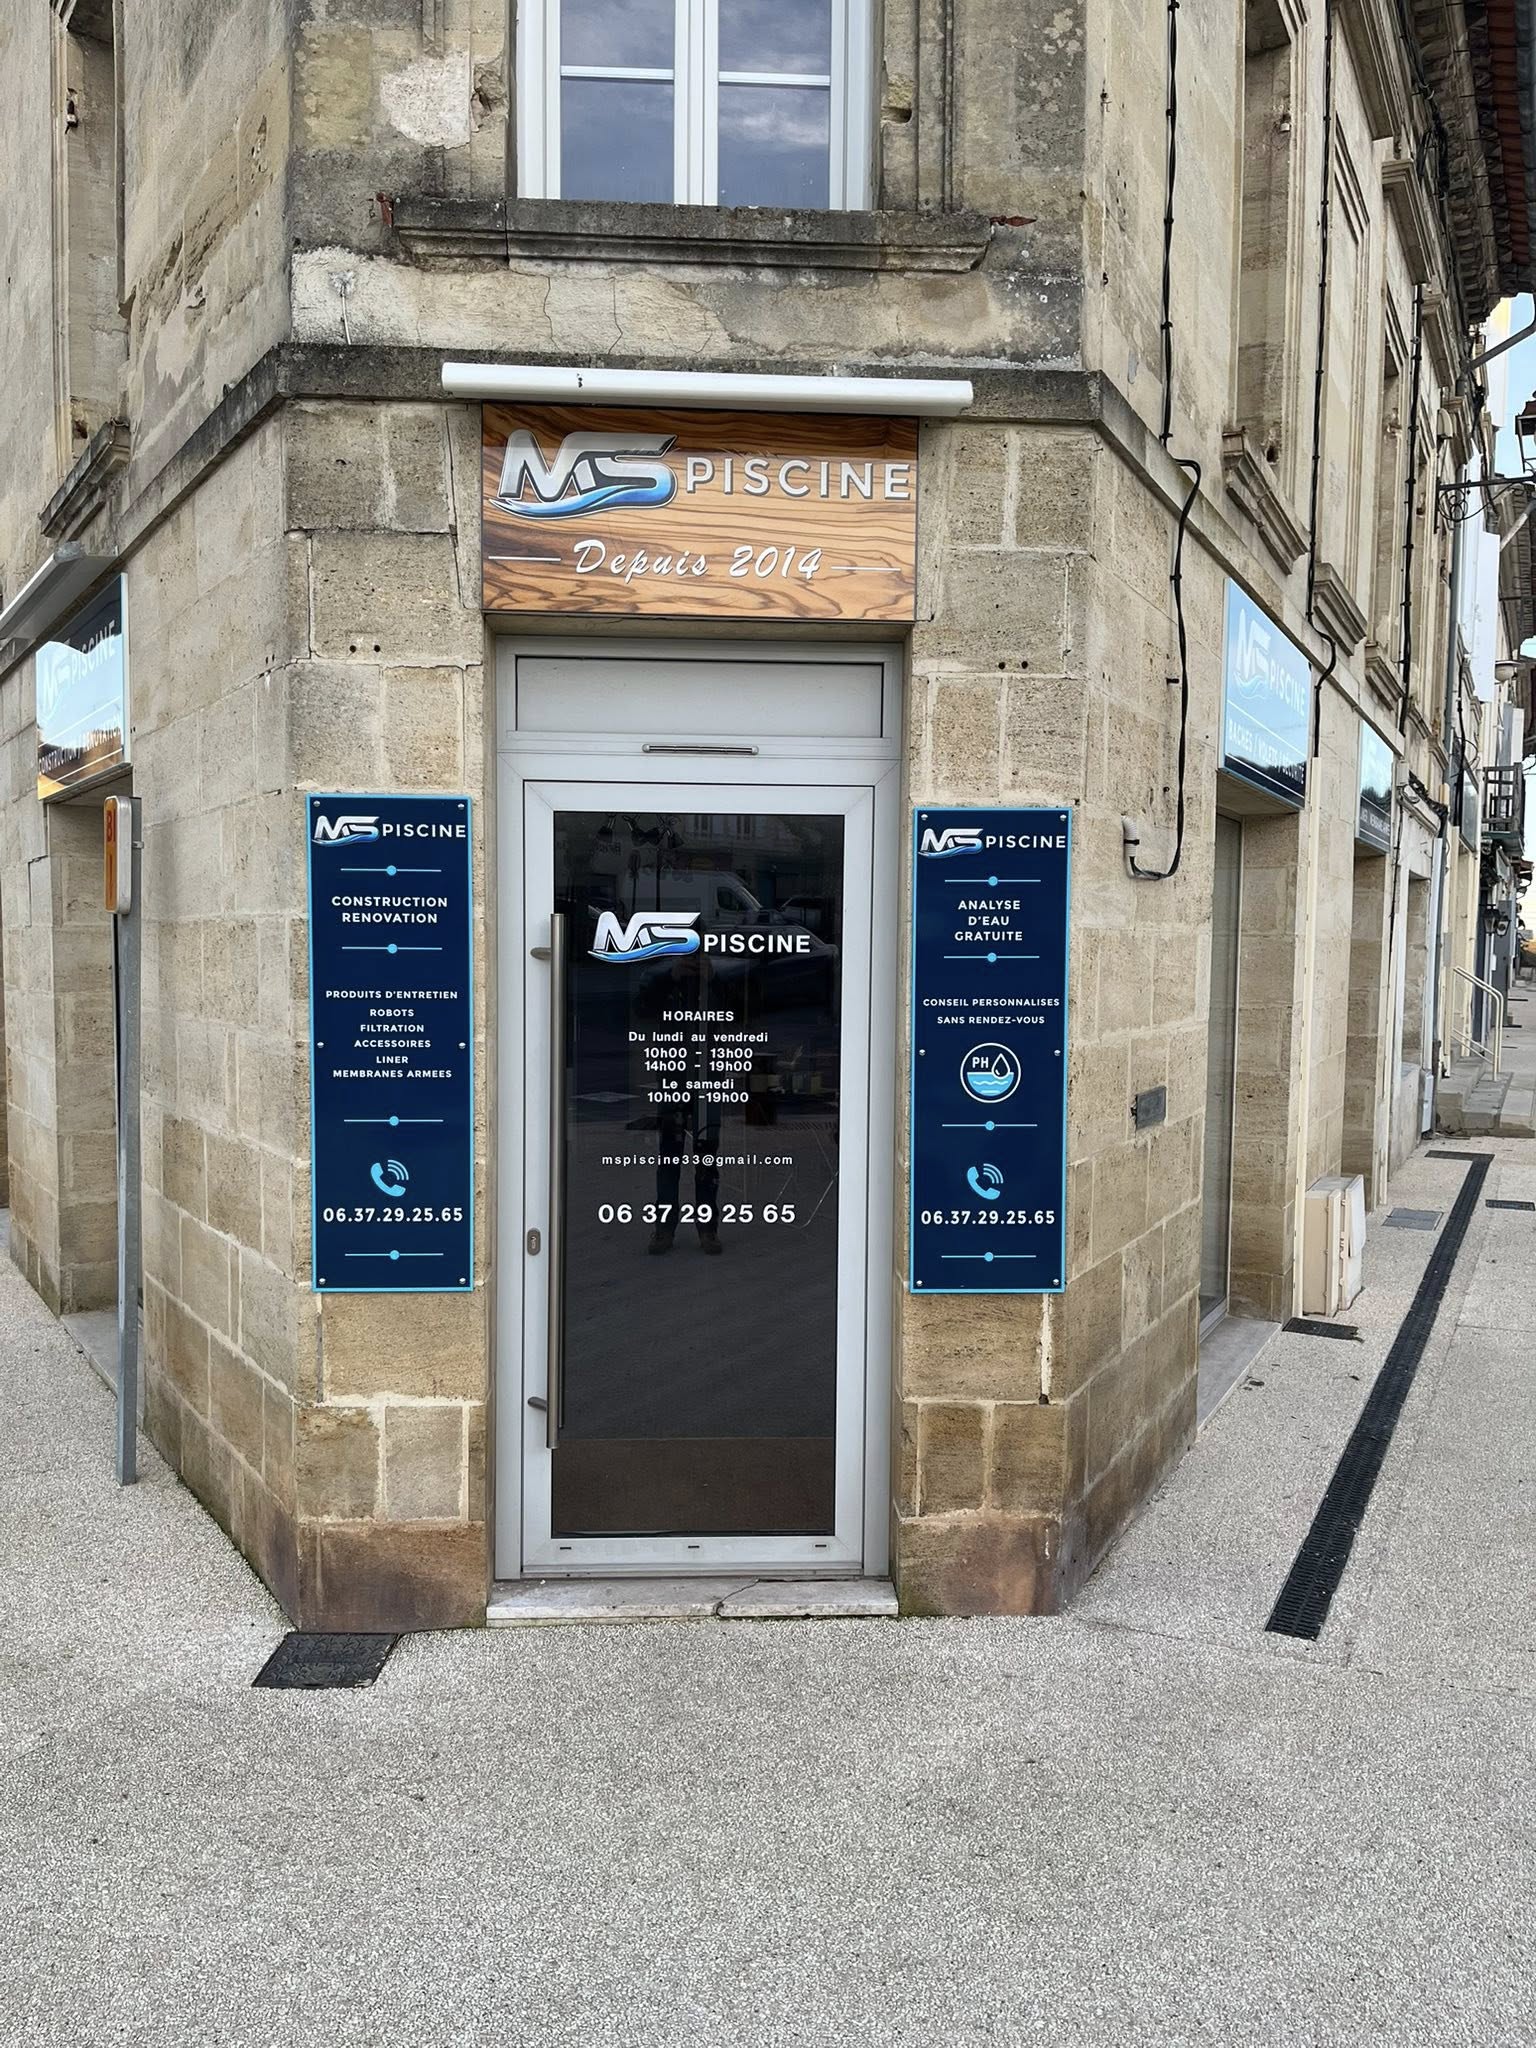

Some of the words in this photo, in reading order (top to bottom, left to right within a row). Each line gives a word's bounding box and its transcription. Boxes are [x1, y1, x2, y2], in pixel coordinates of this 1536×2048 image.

[489, 429, 678, 519] MS
[686, 456, 911, 500] PISCINE
[572, 539, 710, 584] Depuis
[728, 545, 824, 580] 2014
[70, 619, 116, 685] PISCINE
[1270, 664, 1306, 718] PISCINE
[311, 815, 380, 845] MS
[382, 823, 467, 838] PISCINE
[918, 828, 983, 857] MS
[985, 835, 1067, 849] PISCINE
[331, 895, 448, 908] CONSTRUCTION
[957, 899, 1021, 910] ANALYSE
[342, 912, 438, 924] RENOVATION
[968, 915, 1010, 926] D'EAU
[587, 910, 701, 964] MS
[703, 933, 811, 954] PISCINE
[954, 931, 1023, 942] GRATUITE
[325, 990, 382, 999] PRODUITS
[385, 990, 458, 999] D'ENTRETIEN
[922, 998, 969, 1007] CONSEIL
[972, 998, 1060, 1007] PERSONNALISES
[369, 1008, 415, 1017] ROBOTS
[663, 1010, 734, 1022] HORAIRES
[937, 1016, 965, 1024] SANS
[968, 1016, 1045, 1024] RENDEZ-VOUS
[360, 1024, 425, 1033] FILTRATION
[628, 1031, 646, 1042] Du
[652, 1031, 684, 1042] lundi
[690, 1033, 706, 1042] au
[713, 1031, 768, 1043] vendredi
[354, 1039, 431, 1048] ACCESSOIRES
[643, 1047, 688, 1059] 10h00
[710, 1047, 753, 1059] 13h00
[376, 1056, 409, 1064] LINER
[644, 1060, 687, 1072] 14h00
[709, 1060, 753, 1072] 19h00
[972, 1056, 989, 1069] PH
[332, 1069, 403, 1078] MEMBRANES
[406, 1069, 452, 1078] ARMEES
[662, 1078, 679, 1090] Le
[685, 1078, 734, 1090] samedi
[647, 1091, 691, 1103] 10h00
[601, 1154, 793, 1168] mspiscine33@gmail.com
[323, 1207, 463, 1223] 06.37.29.25.65
[598, 1203, 633, 1224] 06
[642, 1203, 673, 1224] 37
[680, 1203, 713, 1224] 29
[721, 1203, 754, 1224] 25
[762, 1203, 796, 1224] 65
[920, 1210, 1055, 1225] 06.37.29.25.65
